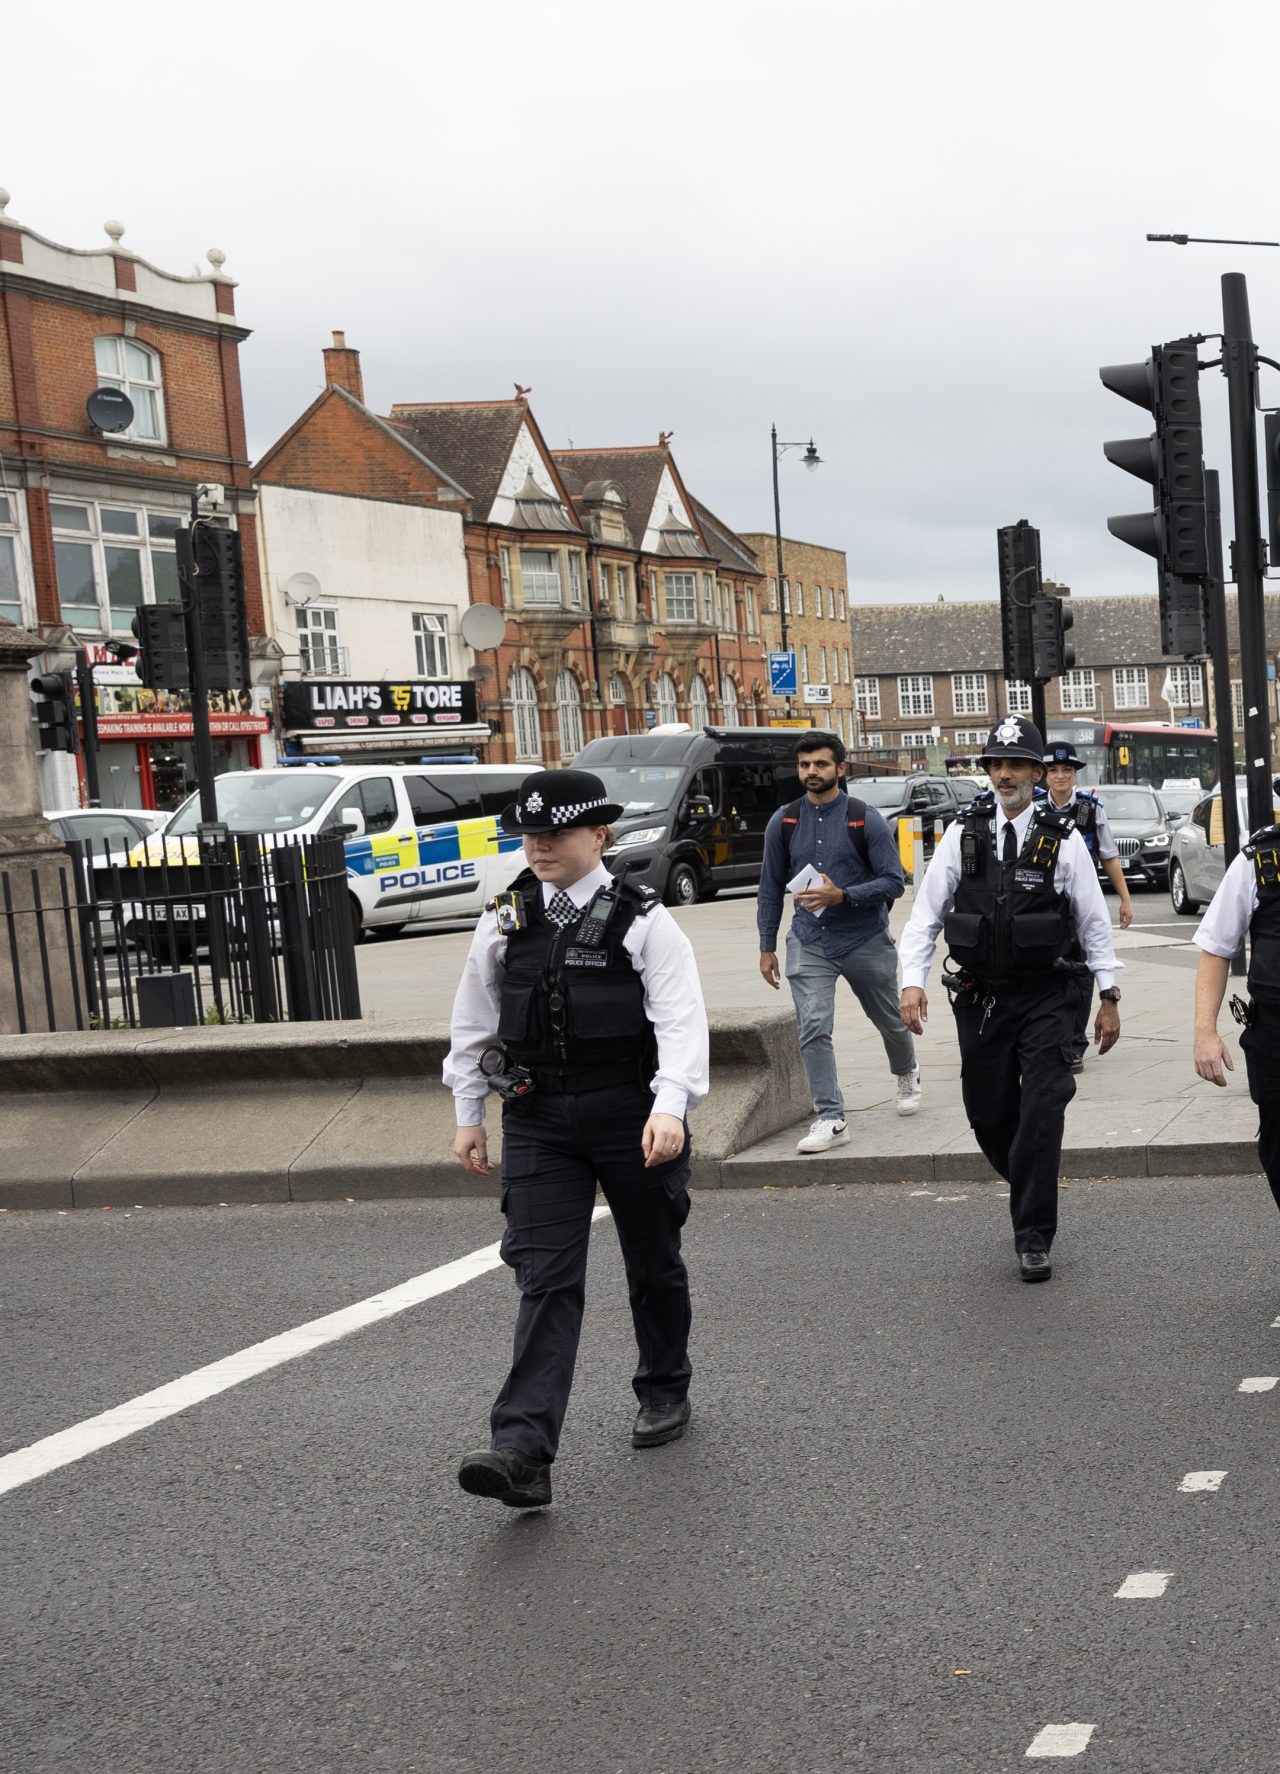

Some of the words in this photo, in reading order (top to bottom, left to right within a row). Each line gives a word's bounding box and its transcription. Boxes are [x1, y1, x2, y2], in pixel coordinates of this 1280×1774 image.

[312, 686, 382, 710] LIAH'S
[123, 723, 147, 733] TRAINING
[147, 723, 153, 733] IS
[153, 722, 178, 733] AVAILABLE
[179, 722, 190, 733] NOW
[222, 722, 229, 731] OR
[229, 722, 240, 731] CALL
[380, 862, 476, 893] POLICE
